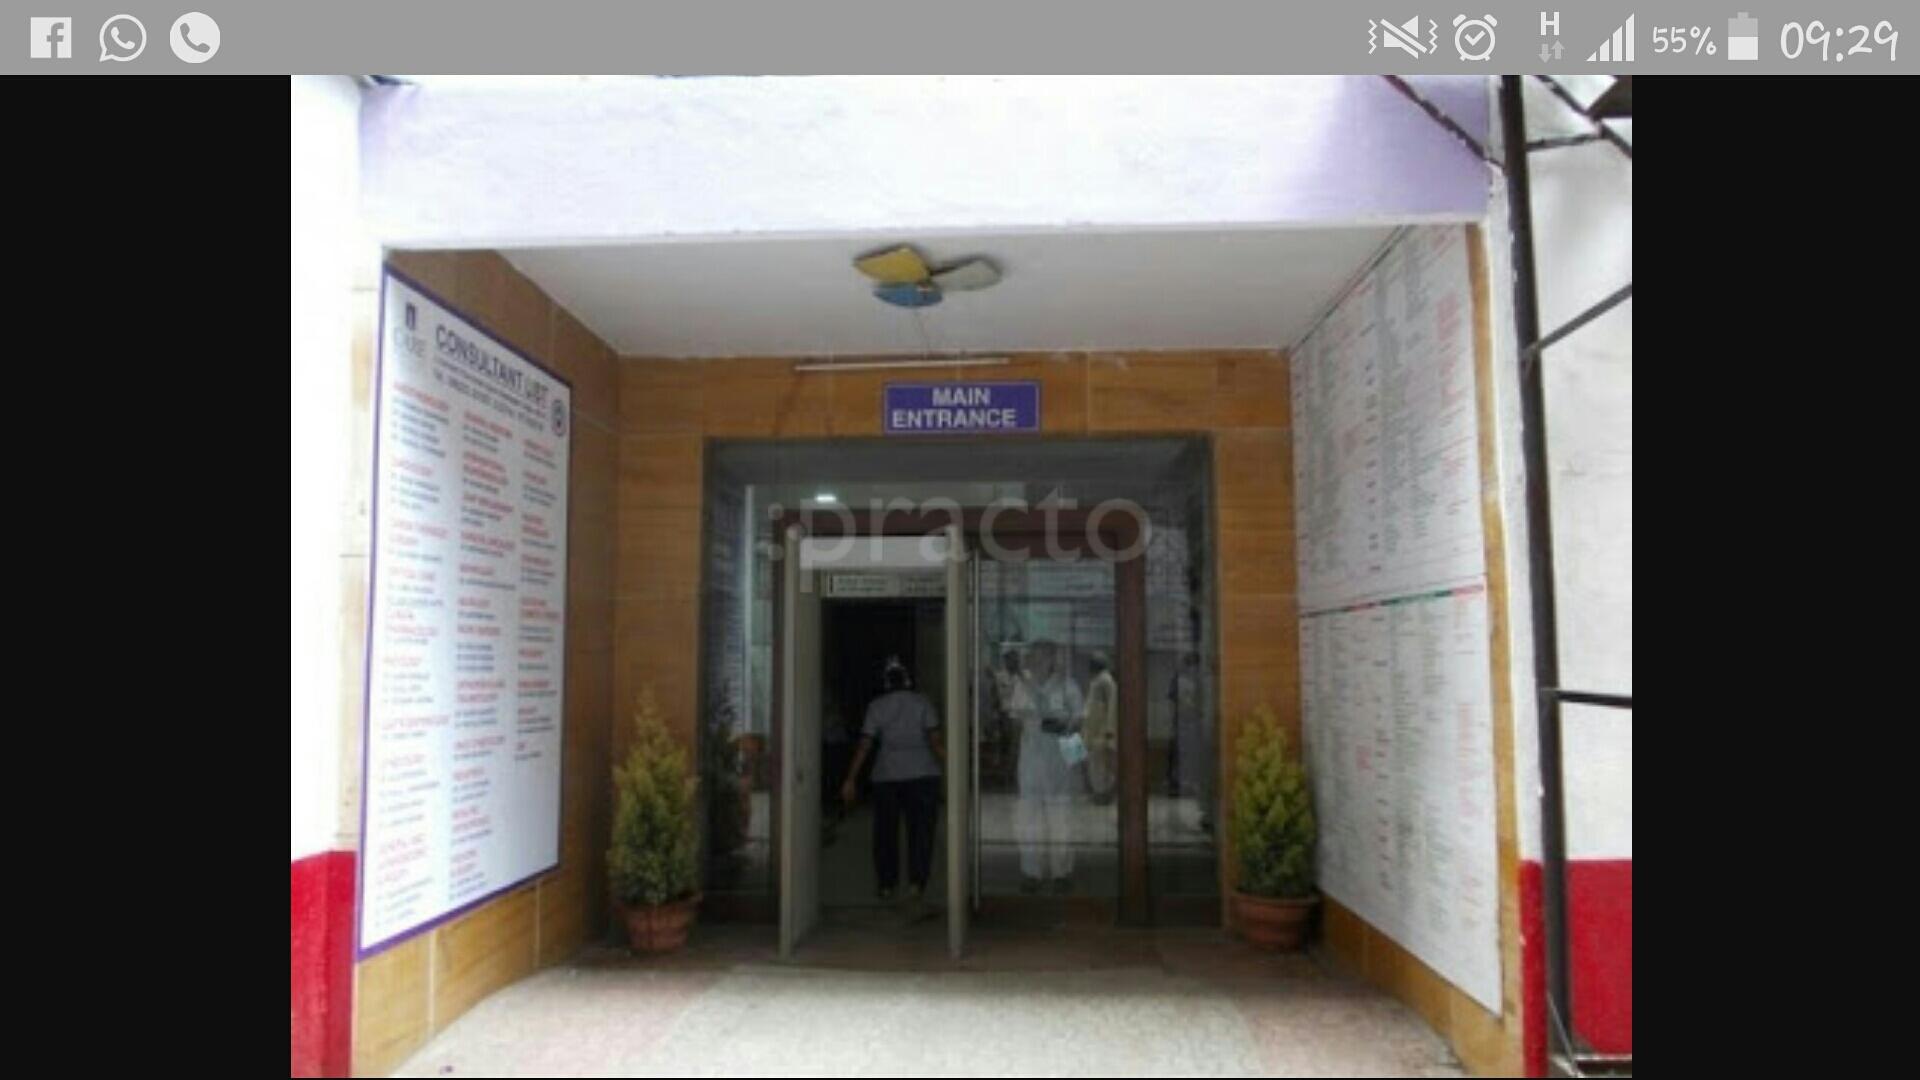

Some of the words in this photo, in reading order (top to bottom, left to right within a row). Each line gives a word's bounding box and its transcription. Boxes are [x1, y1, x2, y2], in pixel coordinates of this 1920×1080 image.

[435, 323, 523, 390] CONSULTANT
[932, 387, 991, 406] MAIN
[892, 408, 1017, 428] ENTRANCE
